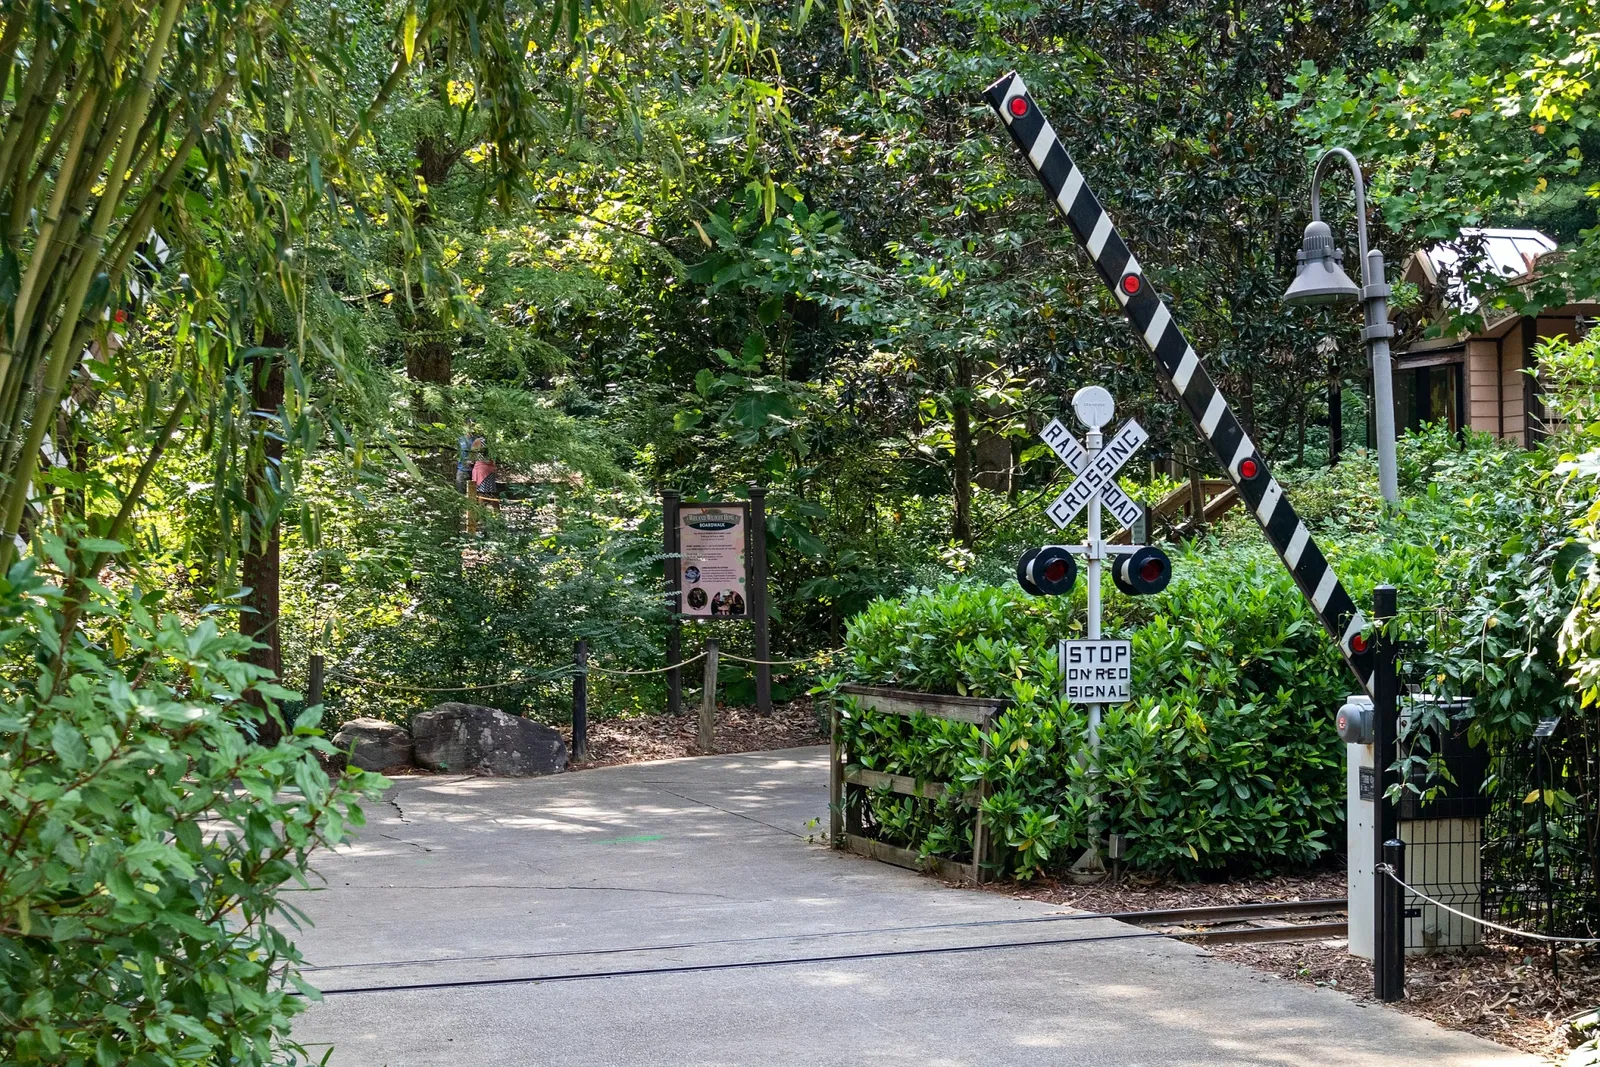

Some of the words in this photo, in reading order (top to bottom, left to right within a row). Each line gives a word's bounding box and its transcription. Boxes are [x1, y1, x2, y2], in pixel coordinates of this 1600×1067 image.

[1045, 424, 1082, 470] RAIL
[1100, 480, 1138, 525] ROAD
[1052, 429, 1140, 524] CROSSING
[1070, 646, 1127, 663] STOP
[1069, 668, 1090, 680] ON
[1095, 668, 1128, 680] RED
[1069, 685, 1128, 698] SIGNAL
